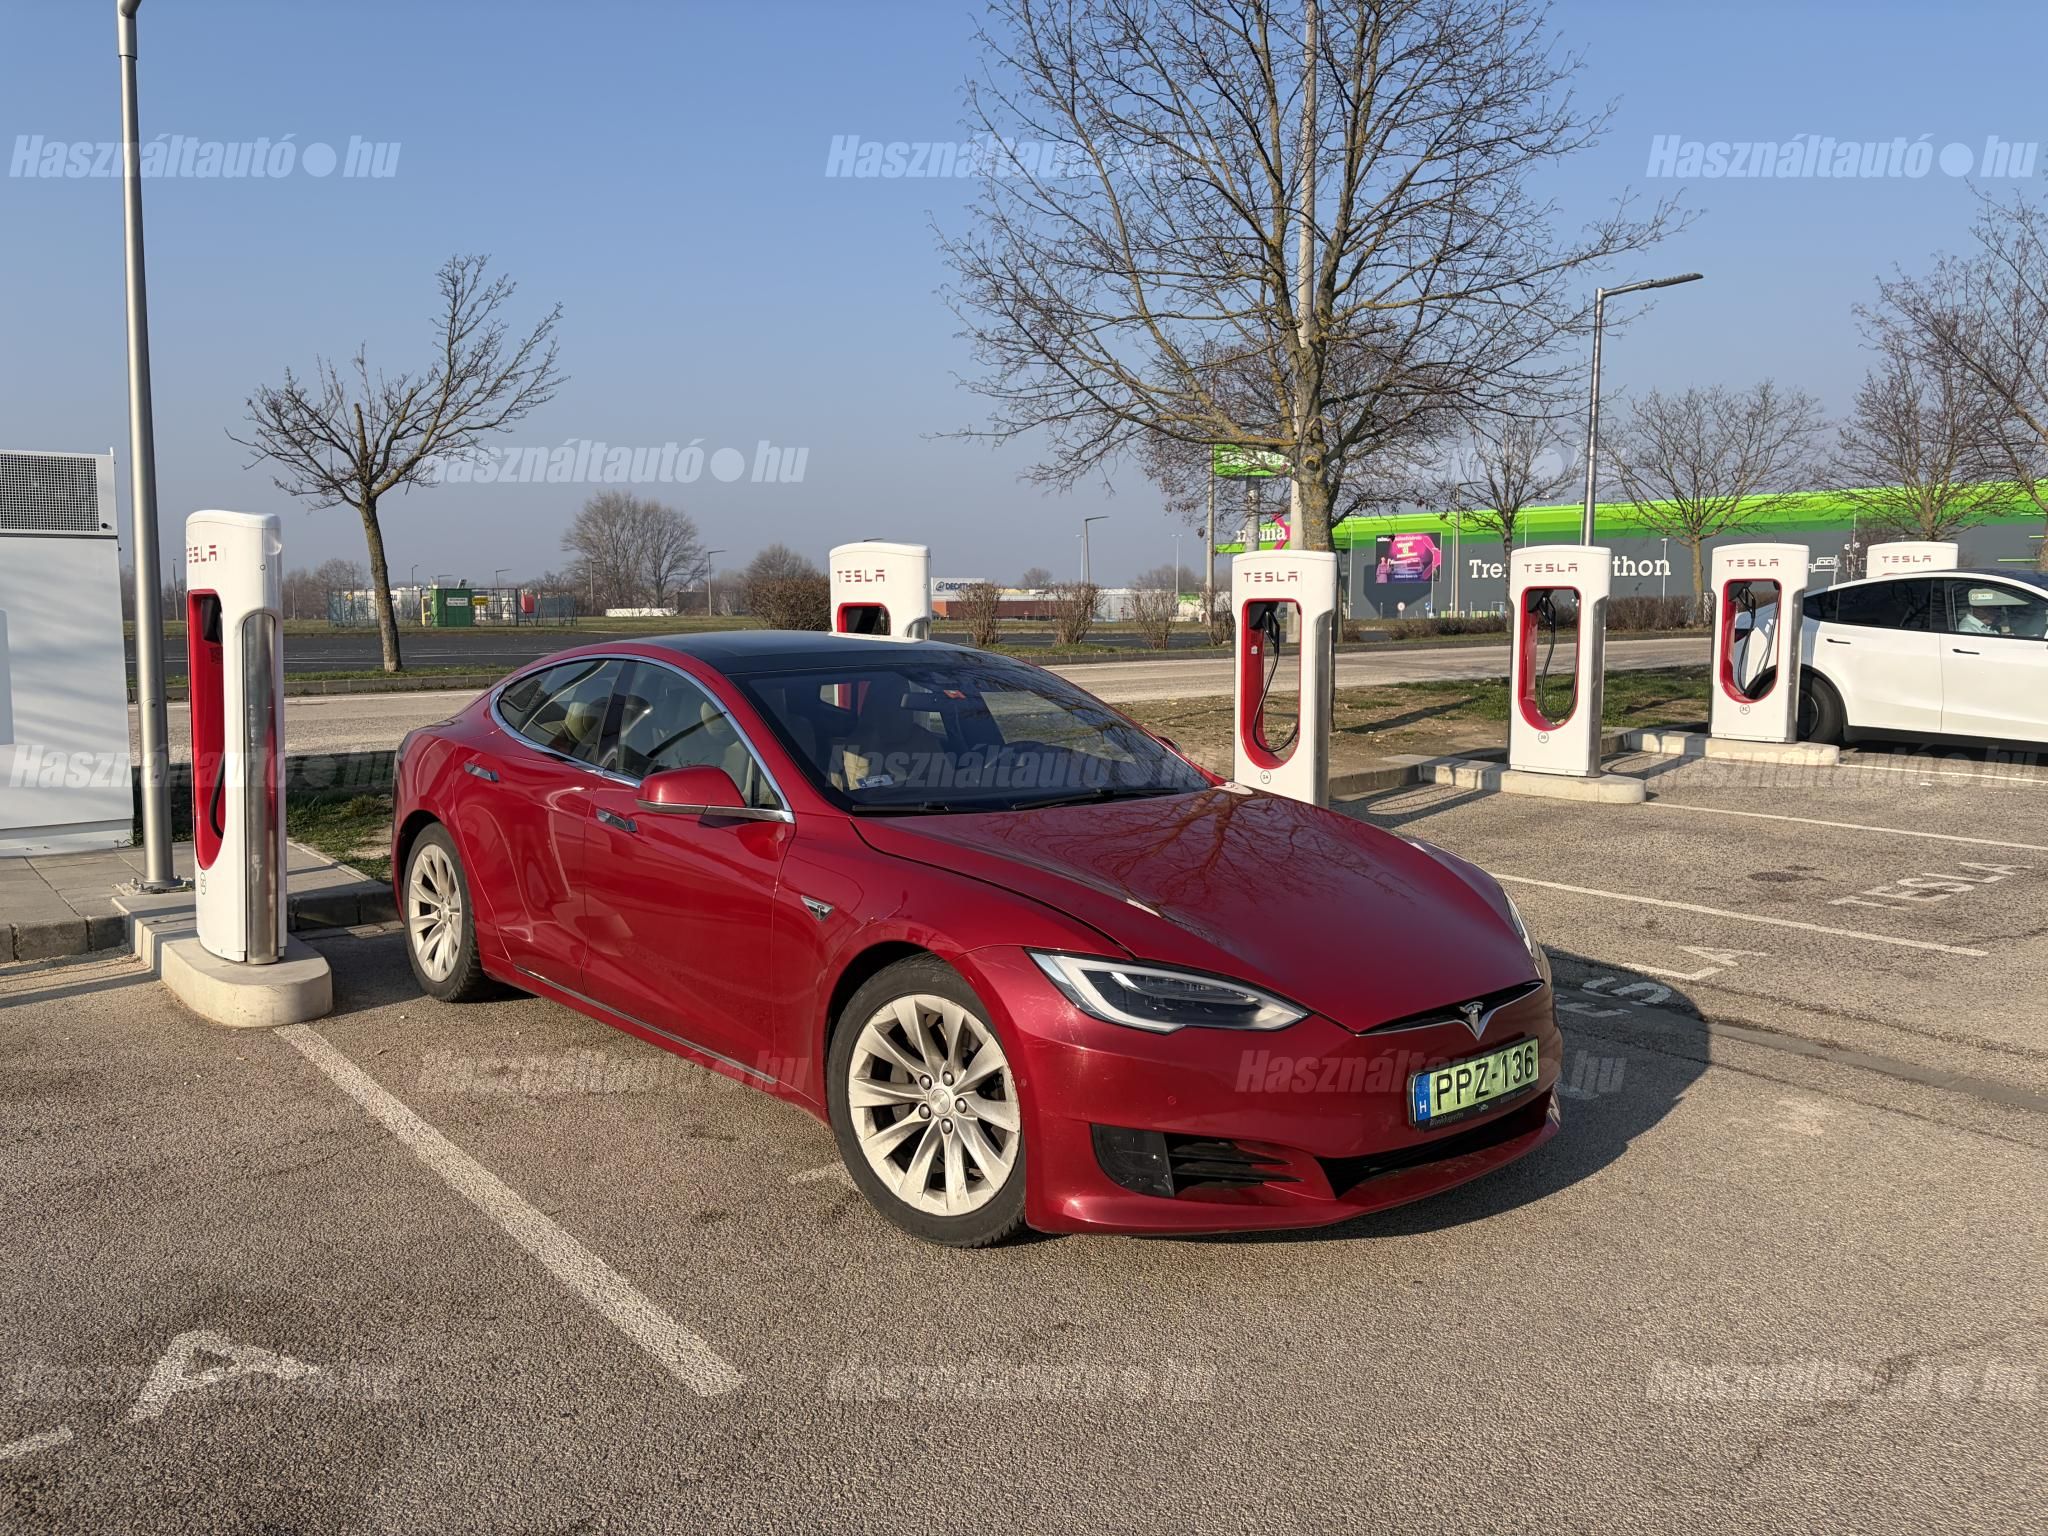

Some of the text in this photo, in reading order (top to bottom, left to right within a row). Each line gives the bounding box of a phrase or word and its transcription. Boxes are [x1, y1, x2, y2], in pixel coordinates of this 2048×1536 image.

[1726, 558, 1779, 568] TESLA
[1881, 555, 1932, 564] TESLA
[1524, 562, 1578, 573] TESLA
[837, 569, 886, 583] TESLA
[1243, 571, 1298, 582] TESLA
[1828, 861, 2035, 911] TESLA
[1436, 1045, 1534, 1111] PPZ-136
[1419, 1100, 1427, 1114] H
